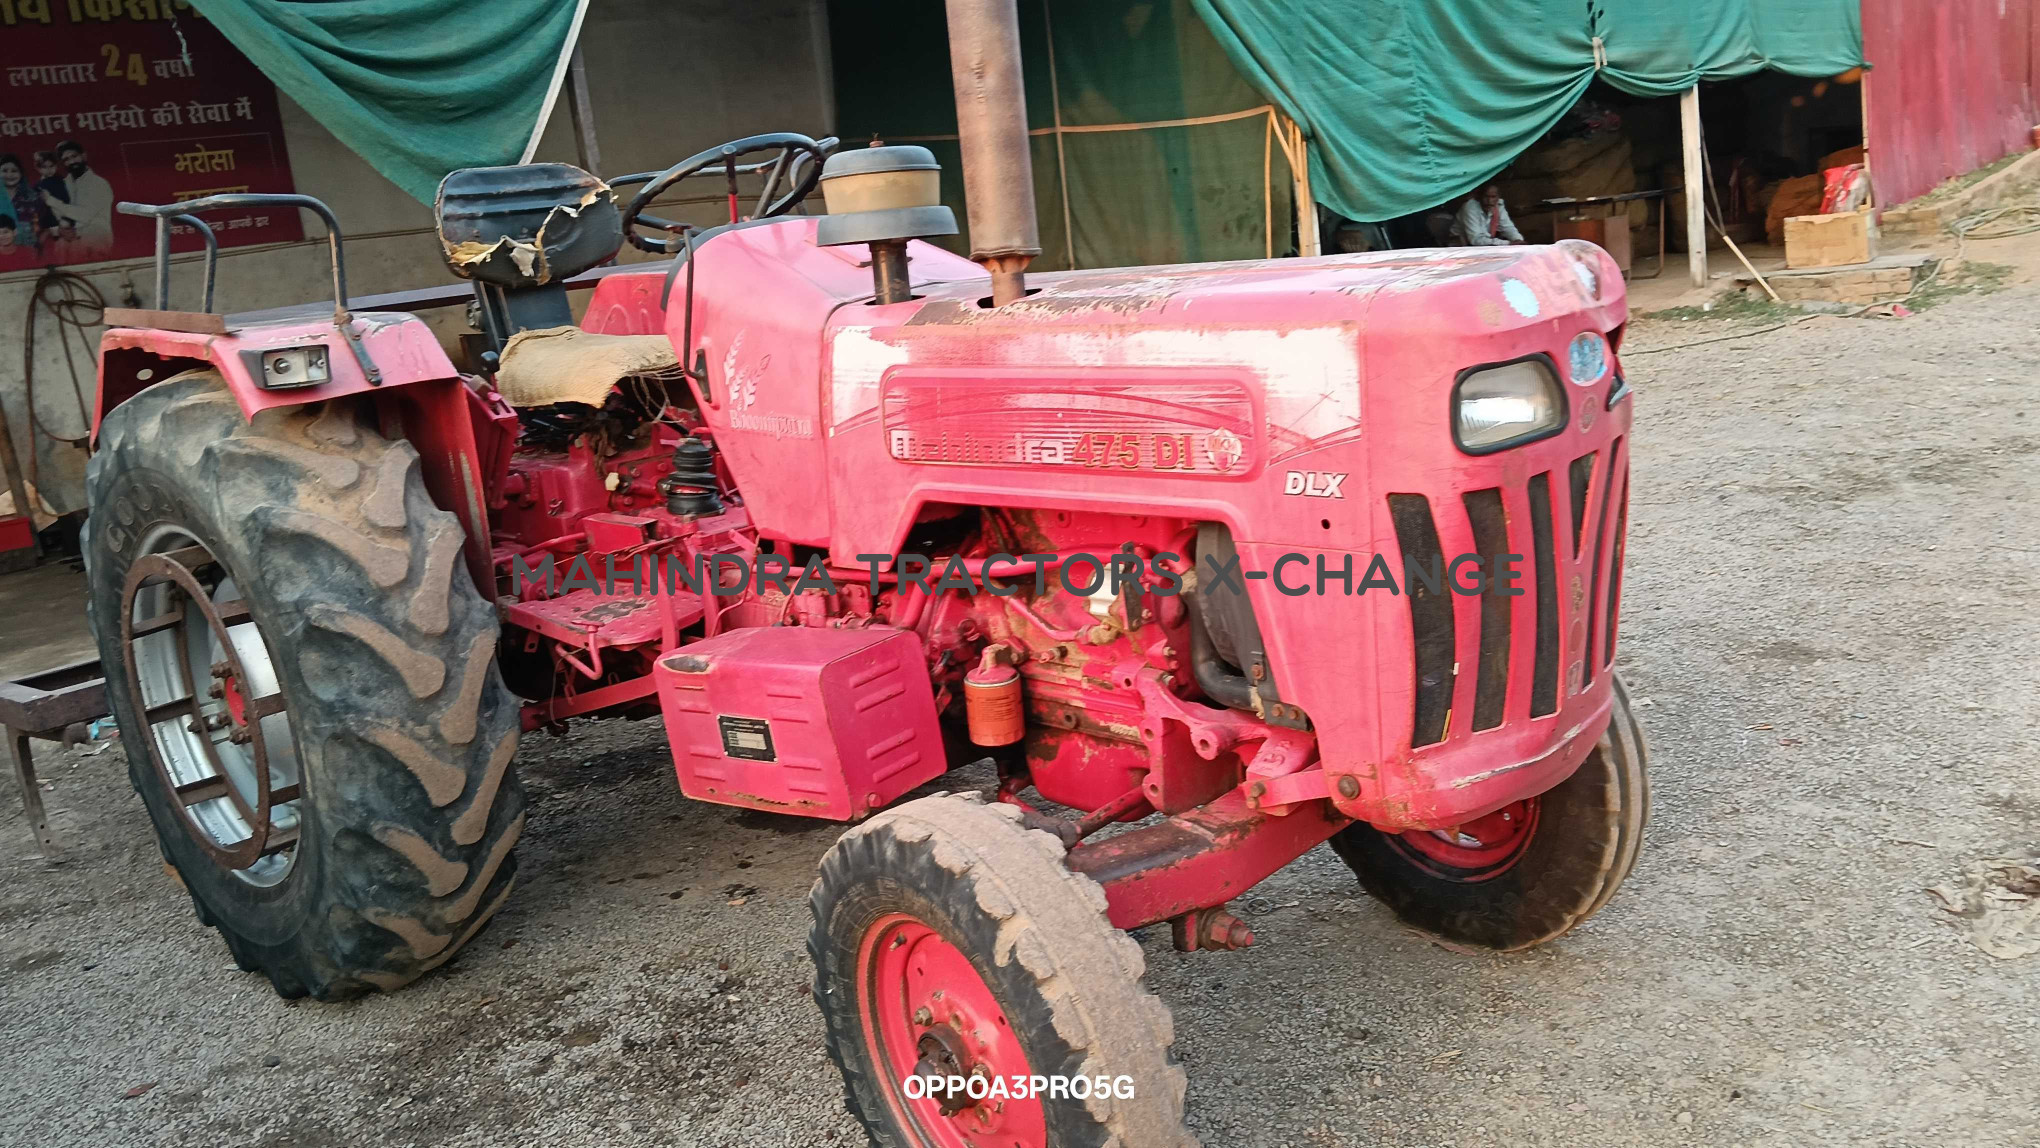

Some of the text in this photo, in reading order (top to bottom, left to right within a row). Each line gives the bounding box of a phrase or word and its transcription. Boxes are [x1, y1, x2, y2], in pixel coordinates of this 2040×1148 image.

[6, 63, 98, 87] लगातार
[101, 44, 148, 86] 24
[151, 101, 183, 128] की
[186, 100, 231, 124] सेवा
[233, 96, 254, 121] में
[174, 144, 236, 175] भरोसा
[1072, 431, 1142, 468] 475
[1153, 432, 1196, 470] DI
[1283, 470, 1348, 499] DLX
